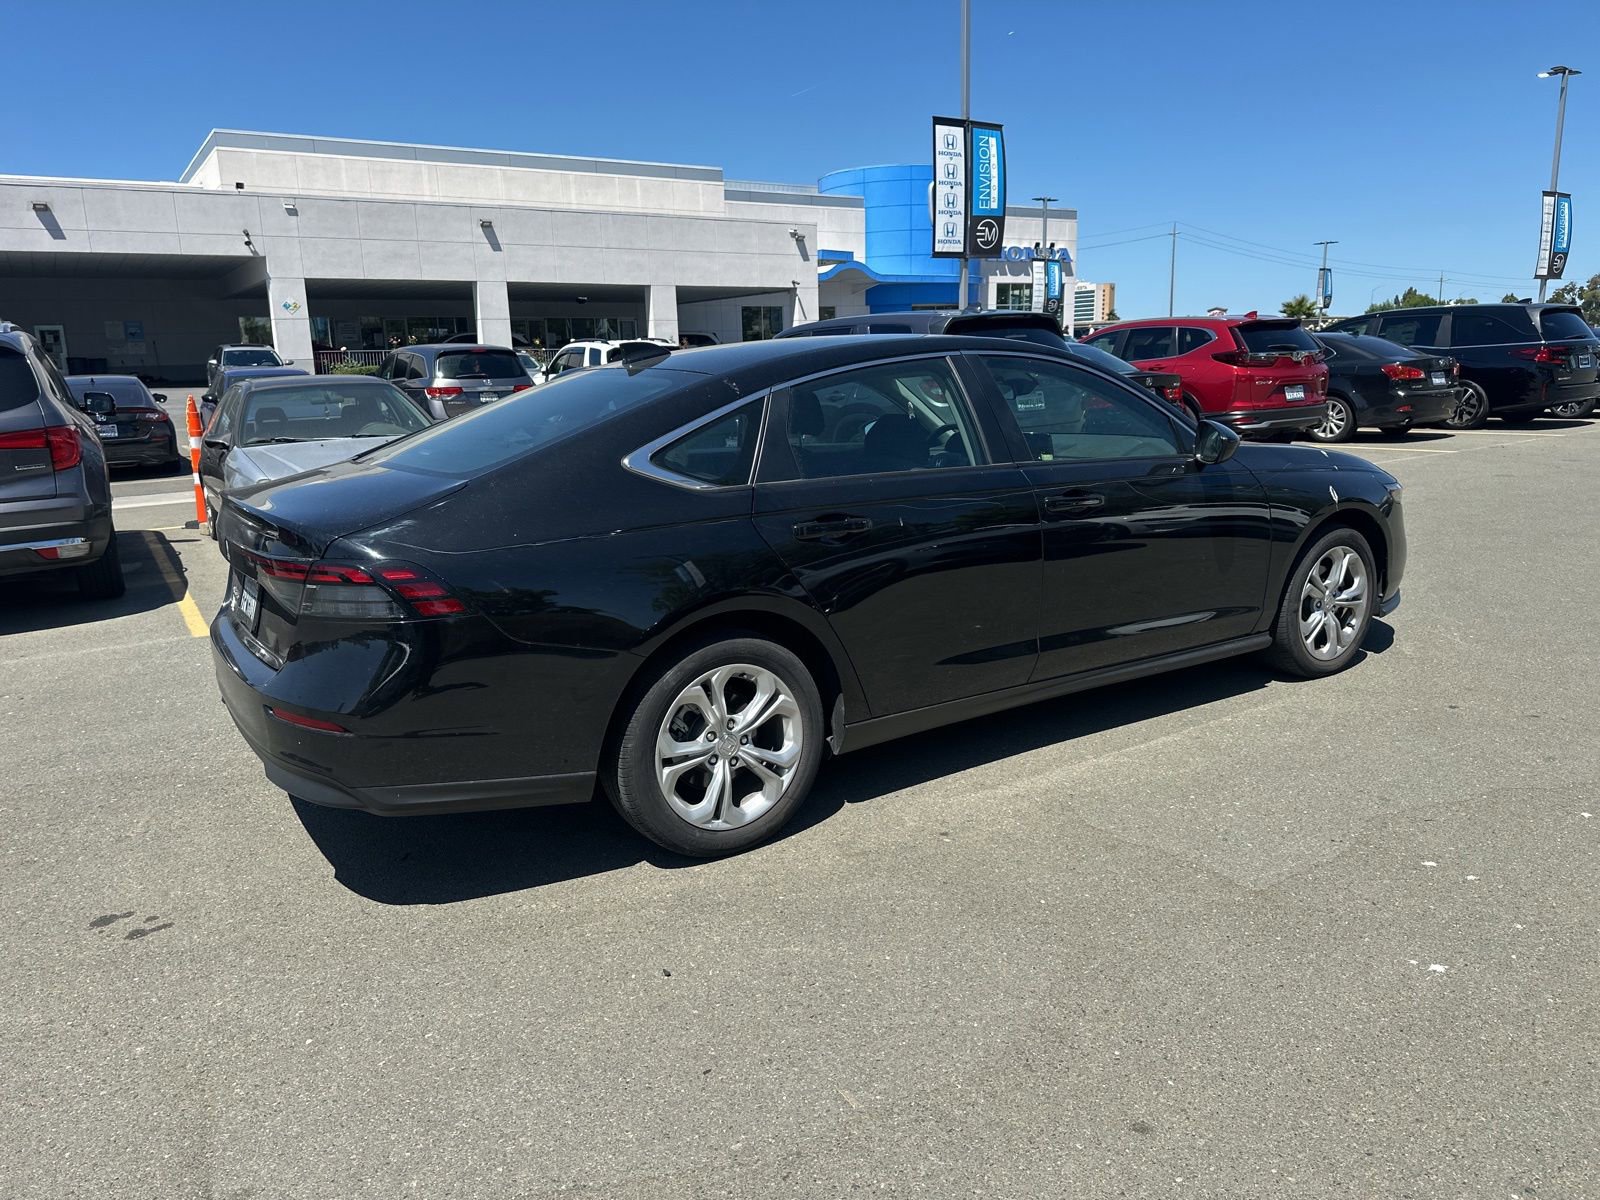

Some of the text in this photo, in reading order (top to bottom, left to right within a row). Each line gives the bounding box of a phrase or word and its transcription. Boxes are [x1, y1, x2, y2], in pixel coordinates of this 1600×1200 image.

[938, 180, 963, 188] HONDA
[979, 135, 990, 209] ENVISION
[1557, 201, 1565, 249] ENVISION
